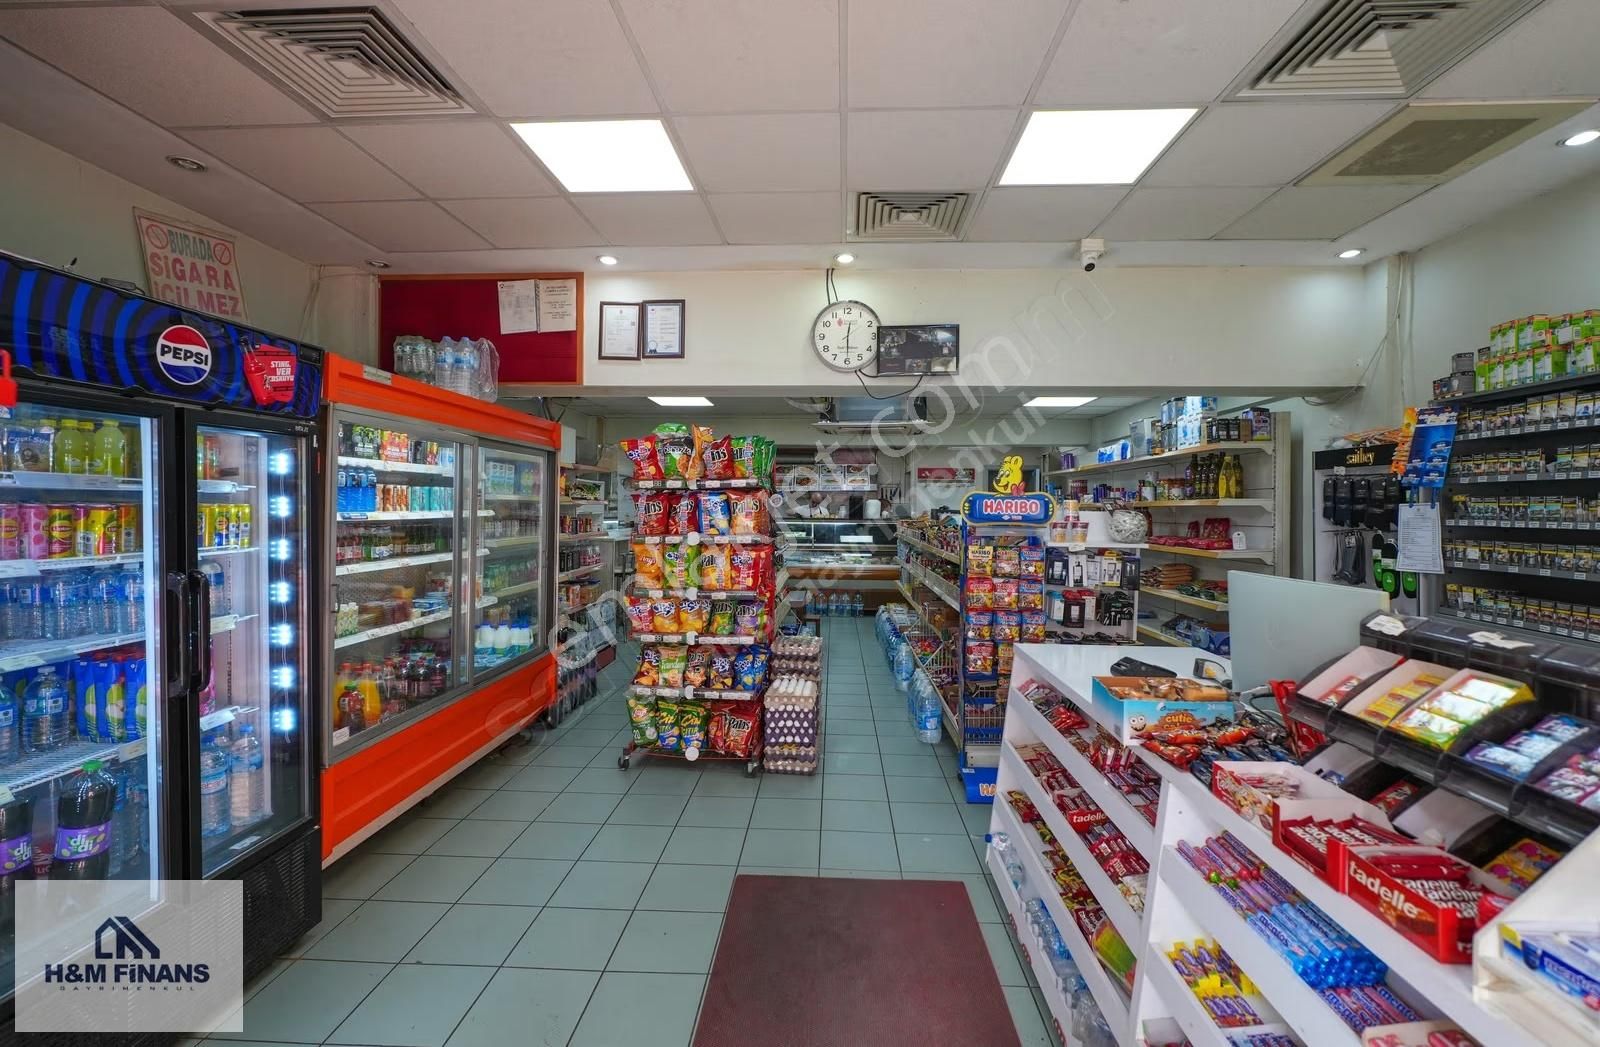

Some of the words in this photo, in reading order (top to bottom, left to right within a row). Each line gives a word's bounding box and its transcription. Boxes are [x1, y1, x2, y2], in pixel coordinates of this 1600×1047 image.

[168, 229, 215, 263] BURADA
[160, 343, 209, 367] PEPSI
[983, 498, 1040, 515] HARIBO
[1349, 861, 1420, 918] tadelle
[1258, 914, 1290, 948] mentos
